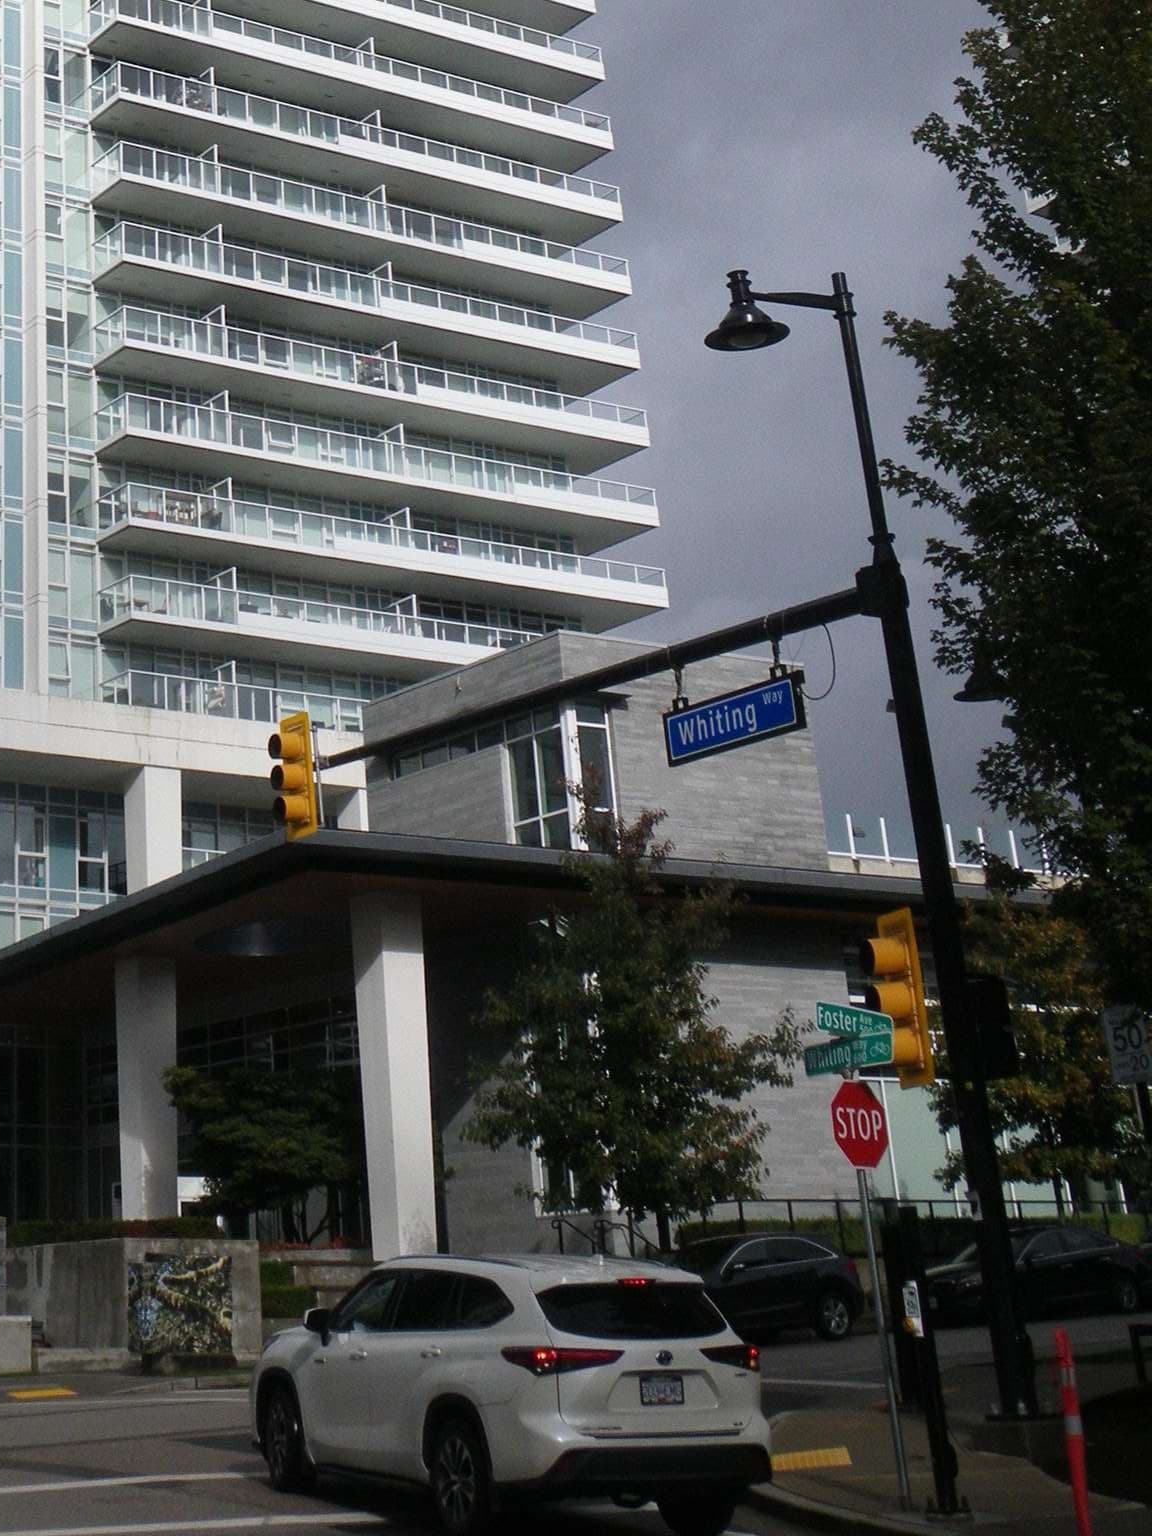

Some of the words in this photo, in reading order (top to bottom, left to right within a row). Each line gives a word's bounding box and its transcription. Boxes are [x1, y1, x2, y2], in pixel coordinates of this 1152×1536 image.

[678, 703, 758, 746] Whiting
[762, 690, 784, 705] Way
[817, 1006, 857, 1033] Foster
[859, 1014, 873, 1026] Ave
[1113, 1024, 1142, 1052] 50
[806, 1044, 851, 1068] Whiting
[836, 1107, 883, 1141] STOP
